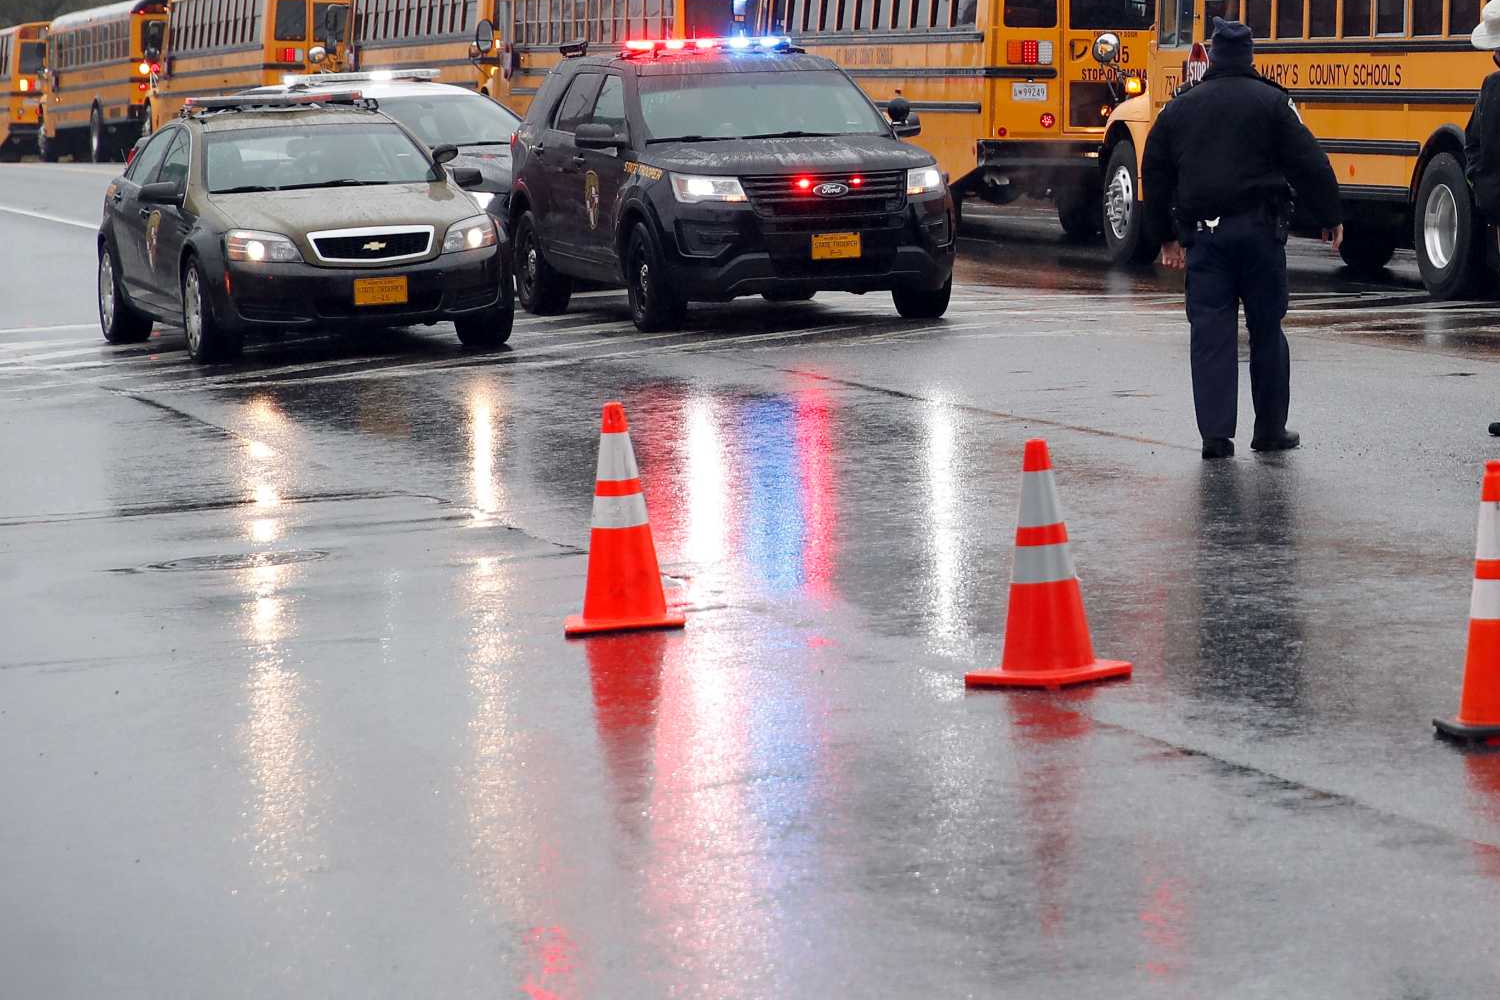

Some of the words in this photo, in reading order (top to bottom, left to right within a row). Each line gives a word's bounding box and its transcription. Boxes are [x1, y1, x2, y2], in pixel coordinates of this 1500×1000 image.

[1082, 69, 1105, 80] STOP
[1122, 69, 1147, 80] SIGNA
[1190, 62, 1206, 86] STOP
[1261, 64, 1299, 85] MARY'S
[1309, 64, 1350, 85] COUNTY
[1353, 64, 1402, 85] SCHOOLS
[821, 184, 841, 194] Ford
